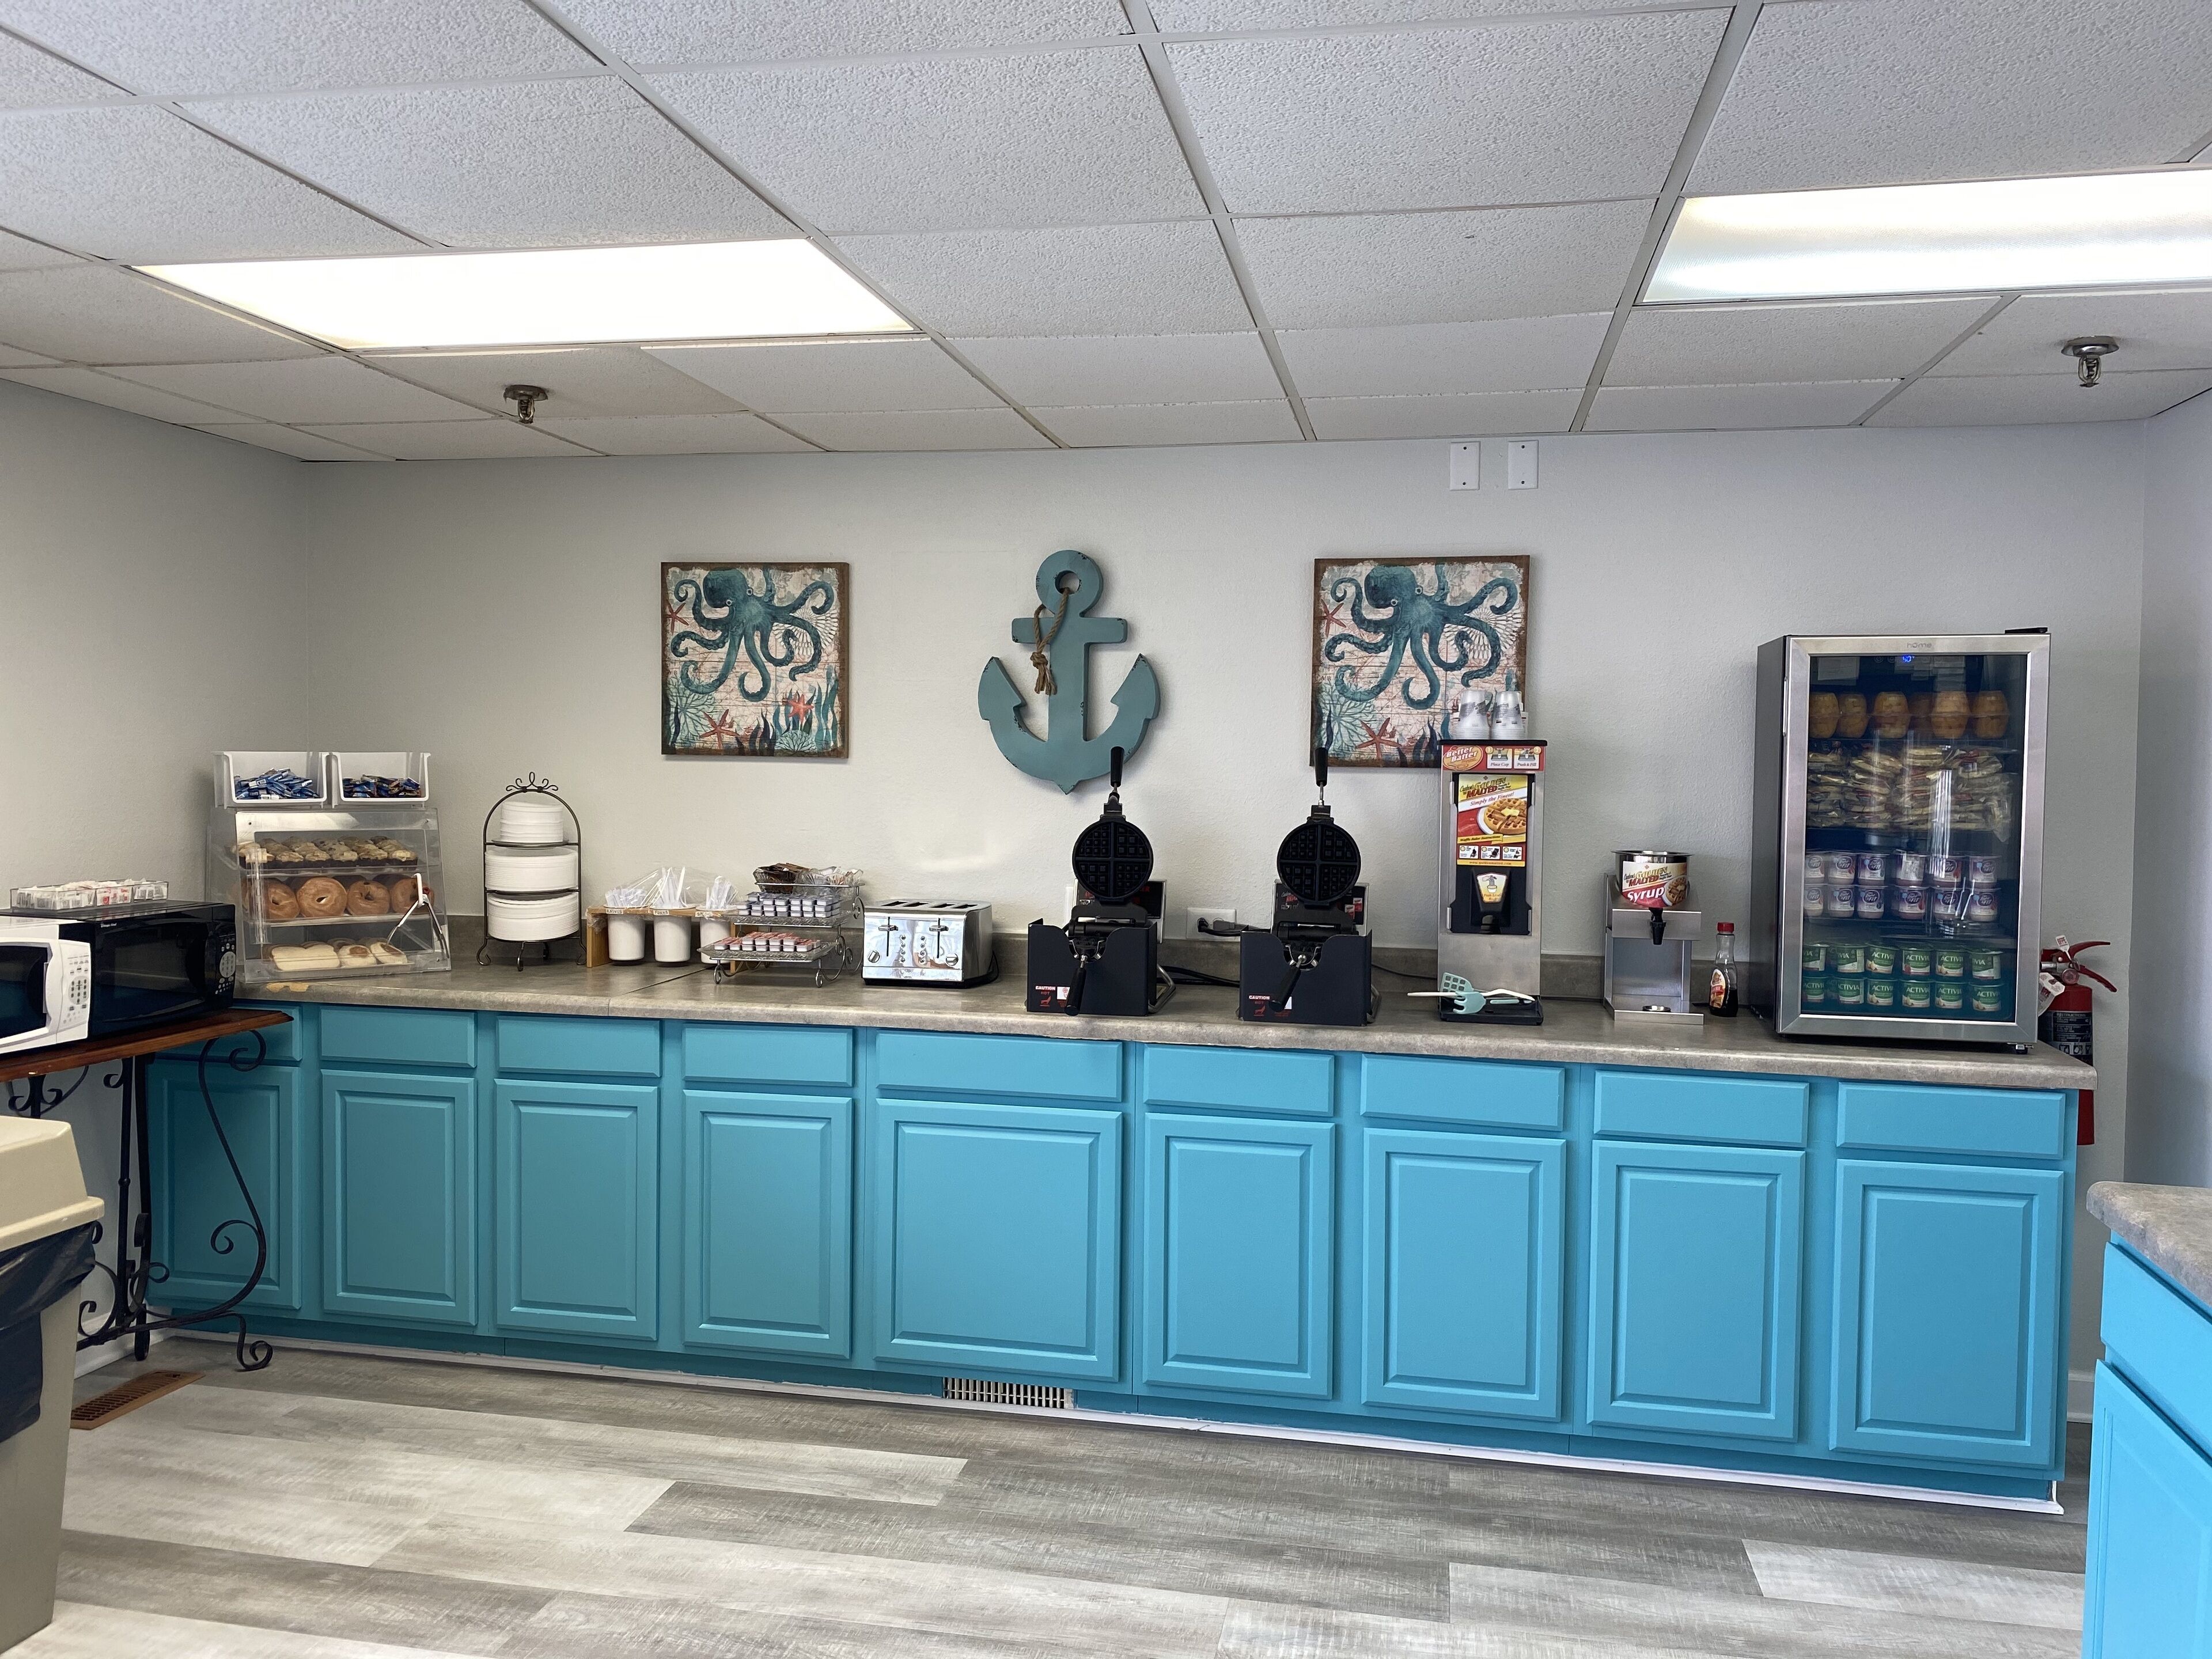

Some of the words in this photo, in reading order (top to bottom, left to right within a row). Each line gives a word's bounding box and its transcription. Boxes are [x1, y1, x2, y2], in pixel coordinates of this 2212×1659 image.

[1446, 747, 1473, 757] Better
[1451, 751, 1478, 762] Batter
[1475, 777, 1506, 790] GOLDEN
[1466, 786, 1498, 798] MALTED
[1498, 791, 1514, 800] Finest!
[1636, 866, 1668, 879] GOLDEN
[1628, 875, 1660, 887] MALTED
[1627, 887, 1664, 903] Syrup
